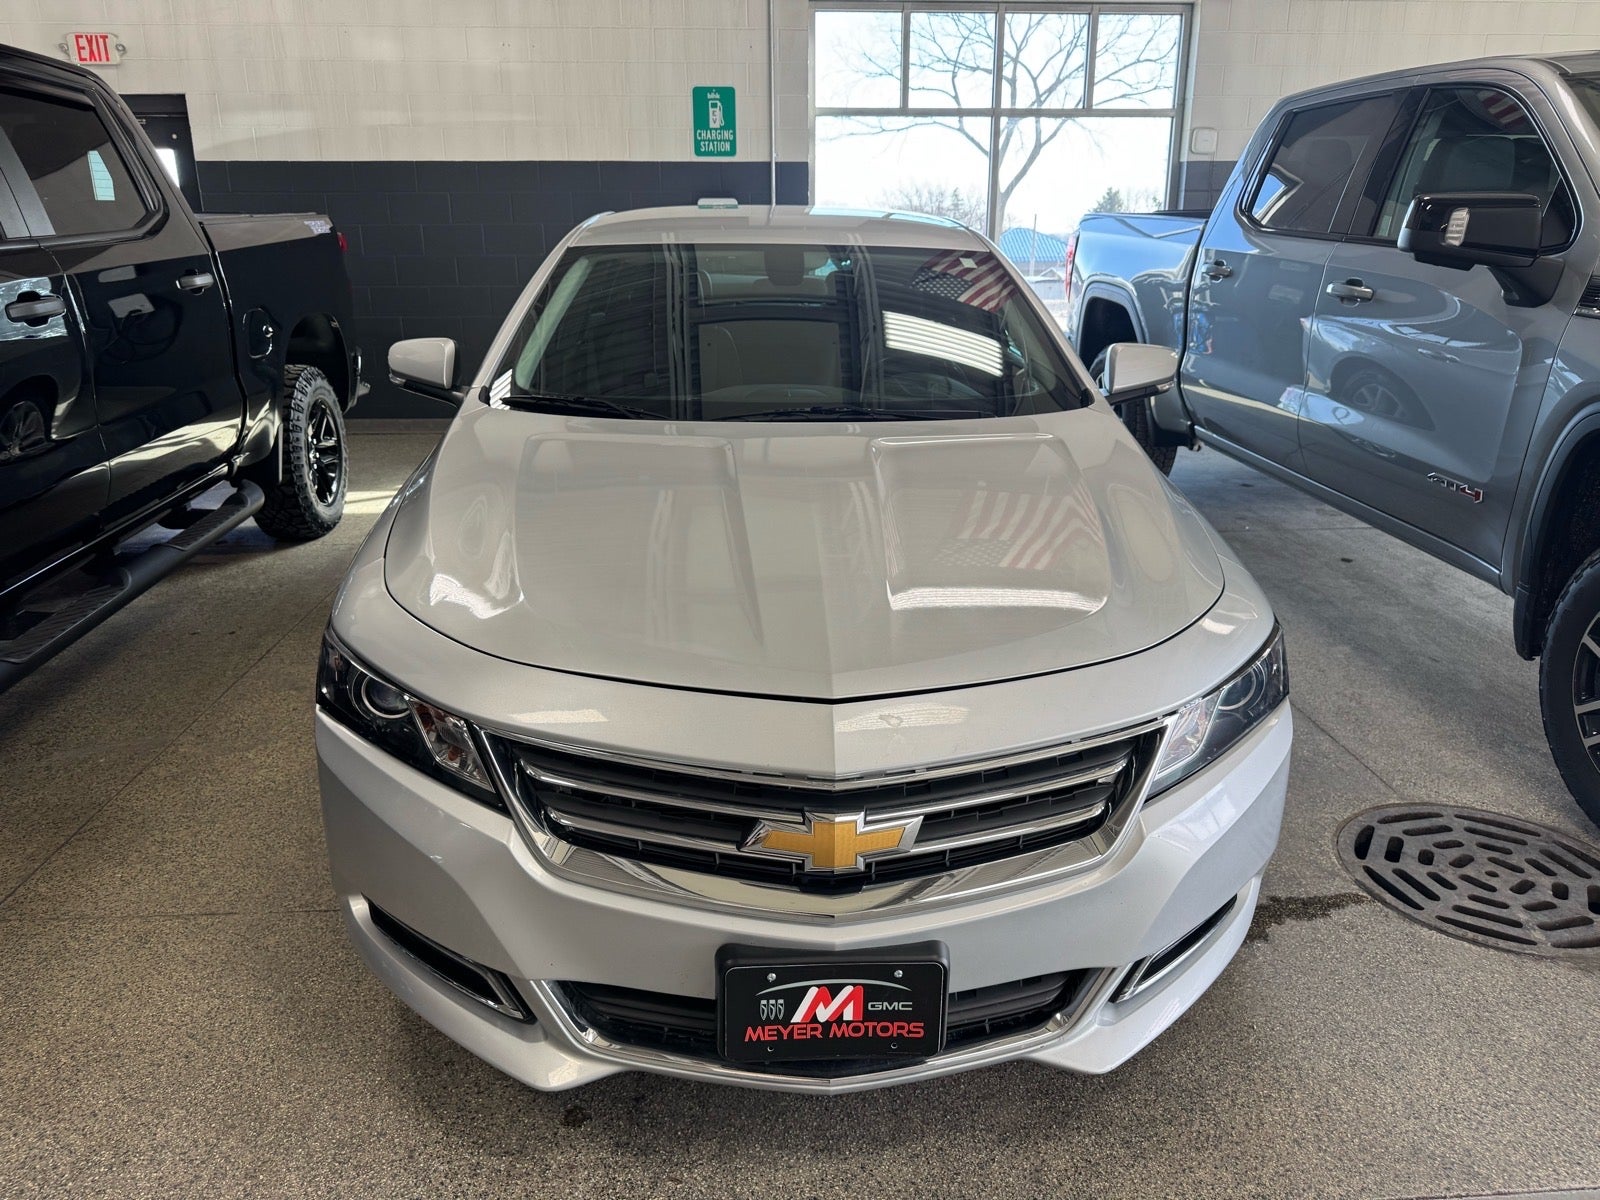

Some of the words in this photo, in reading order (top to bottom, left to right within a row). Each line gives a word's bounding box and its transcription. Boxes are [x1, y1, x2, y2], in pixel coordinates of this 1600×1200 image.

[75, 34, 110, 62] EXIT
[697, 129, 733, 140] CHARGING
[700, 141, 730, 152] STATION
[868, 1001, 913, 1011] GMC
[744, 1023, 823, 1042] MEYER
[829, 1021, 924, 1039] MOTORS
